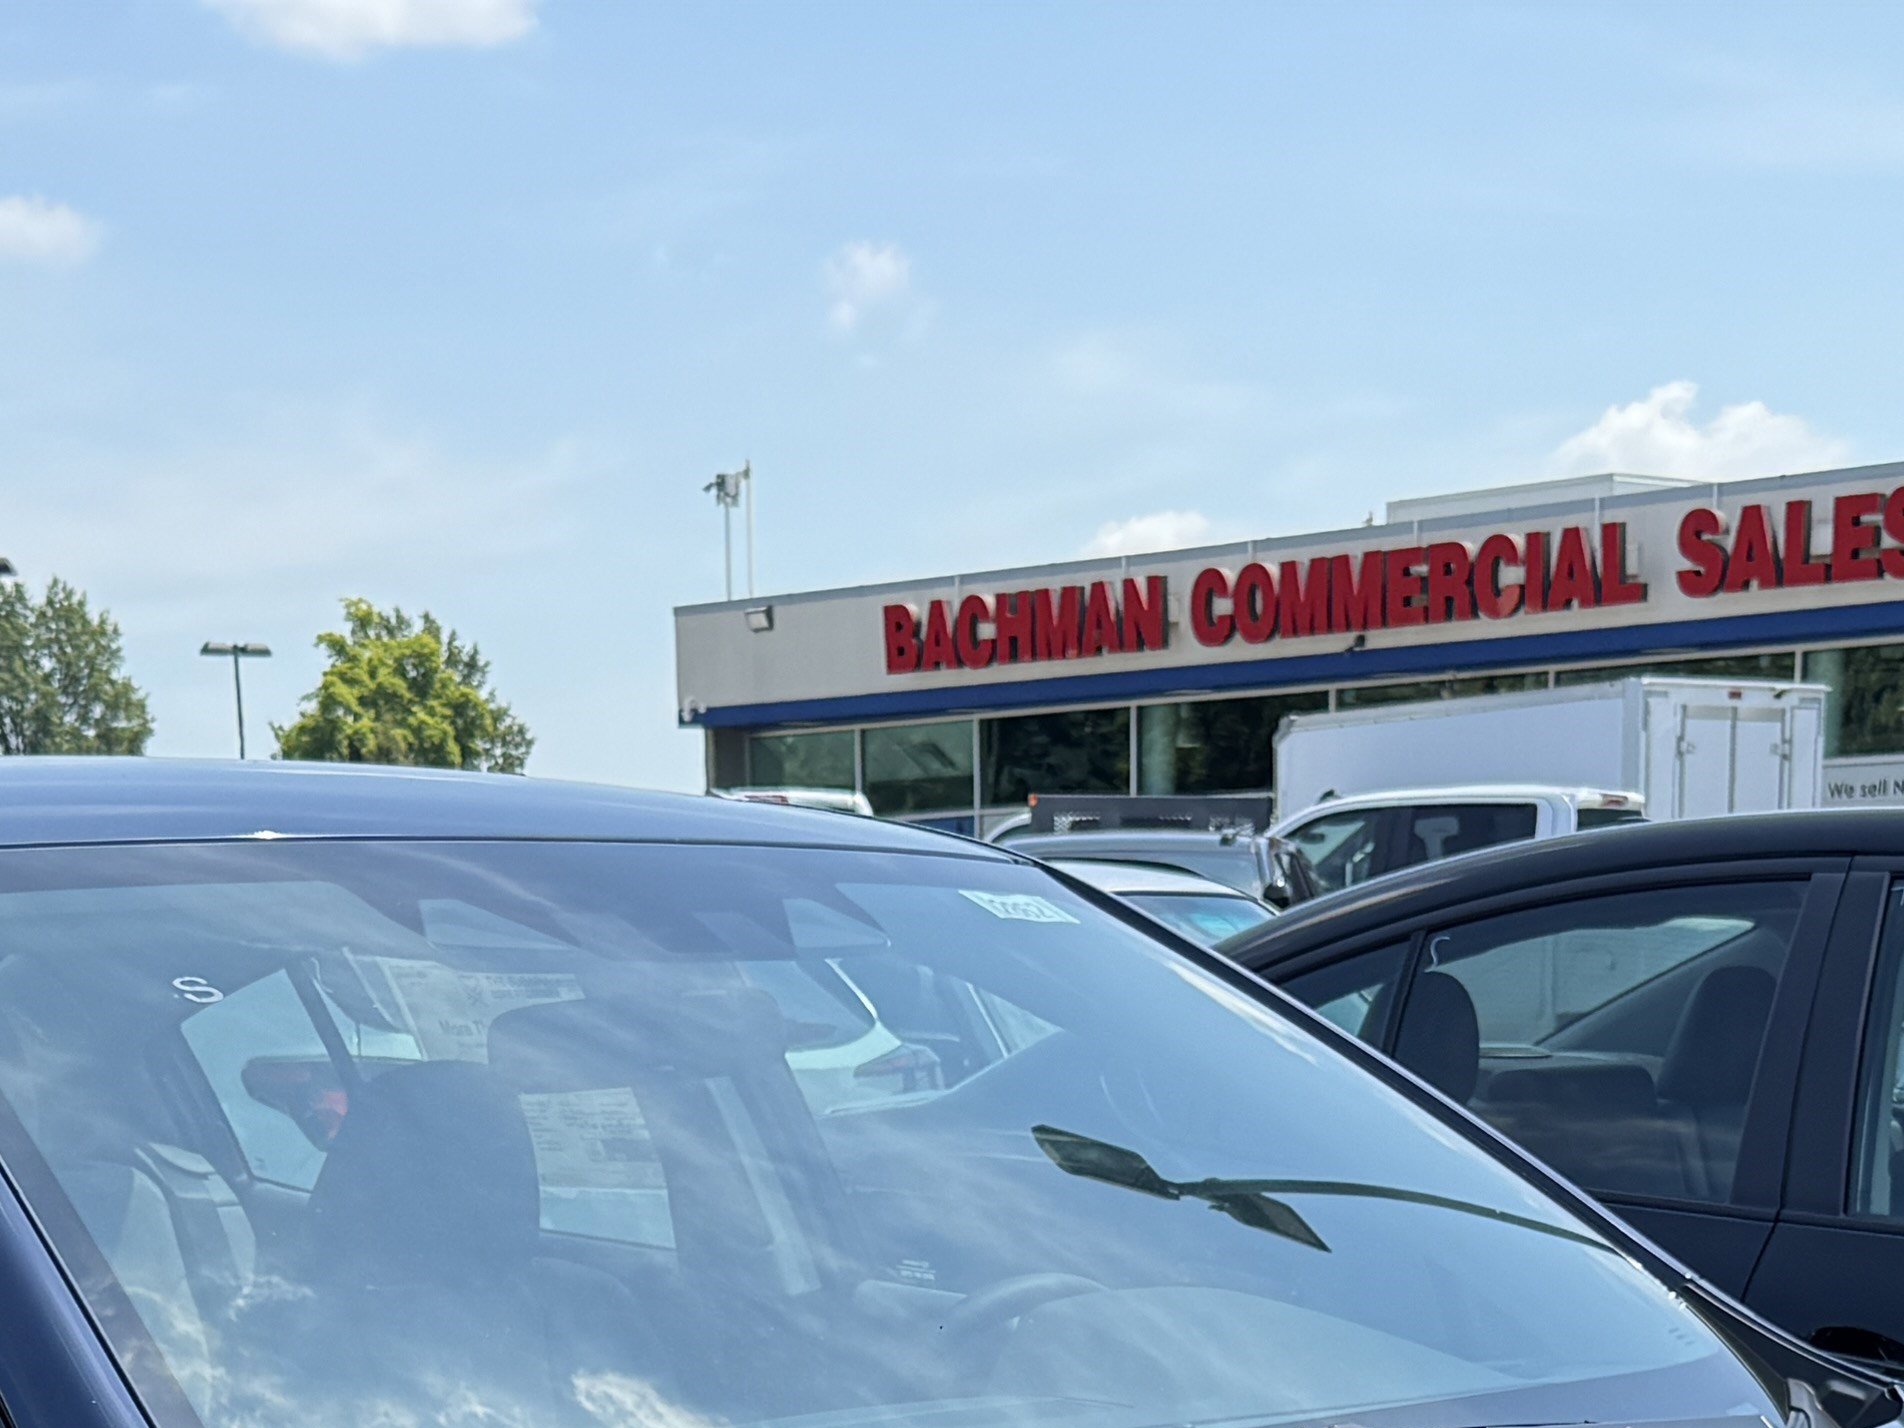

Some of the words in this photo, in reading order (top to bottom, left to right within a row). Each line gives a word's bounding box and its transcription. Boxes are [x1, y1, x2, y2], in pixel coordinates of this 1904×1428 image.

[883, 575, 1168, 675] BACHMAN
[1190, 522, 1647, 648] COMMERCIAL
[1828, 782, 1854, 798] We
[1860, 778, 1887, 798] sell
